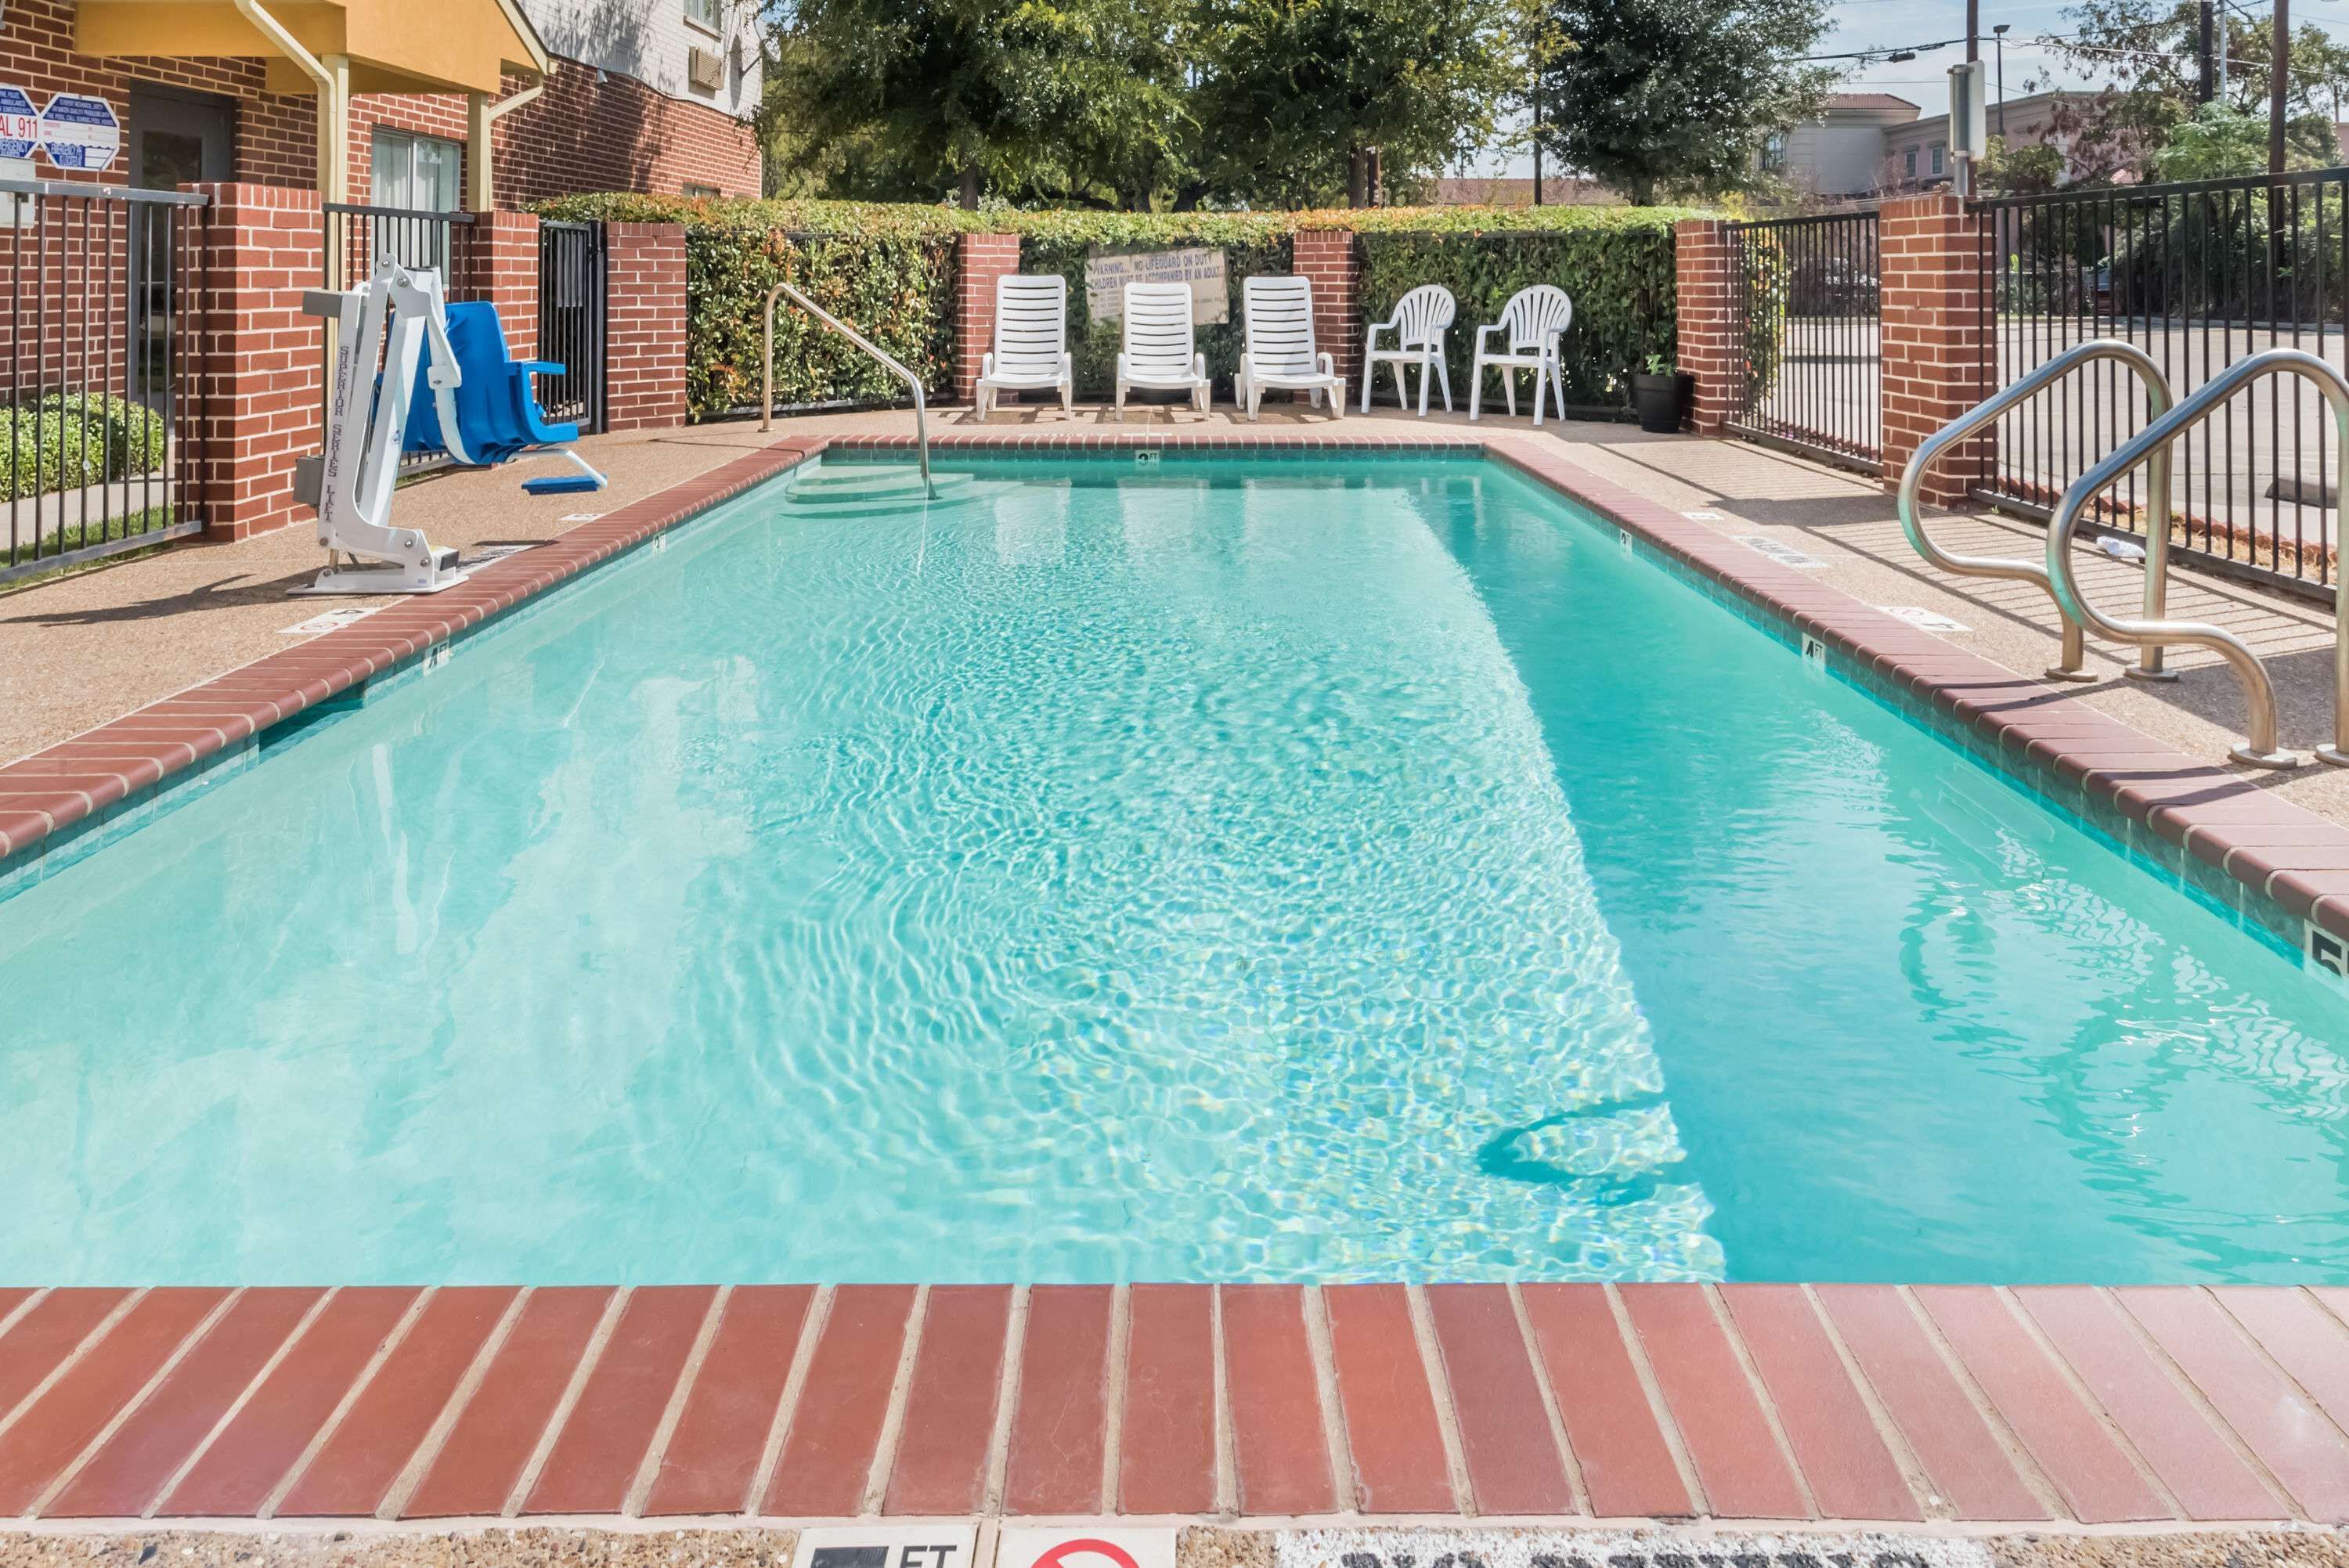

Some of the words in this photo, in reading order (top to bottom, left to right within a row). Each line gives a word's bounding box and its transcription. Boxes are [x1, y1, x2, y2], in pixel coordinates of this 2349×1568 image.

[18, 117, 38, 139] 911
[1134, 261, 1143, 272] NO
[1146, 255, 1181, 271] LIFEGUARD
[1183, 254, 1193, 267] ON
[1195, 254, 1211, 266] DUTY
[1195, 268, 1202, 280] AN
[334, 345, 349, 416] SUPERIOR
[328, 424, 341, 478] SERIES
[325, 485, 335, 523] LIFT
[900, 1545, 958, 1568] FT
